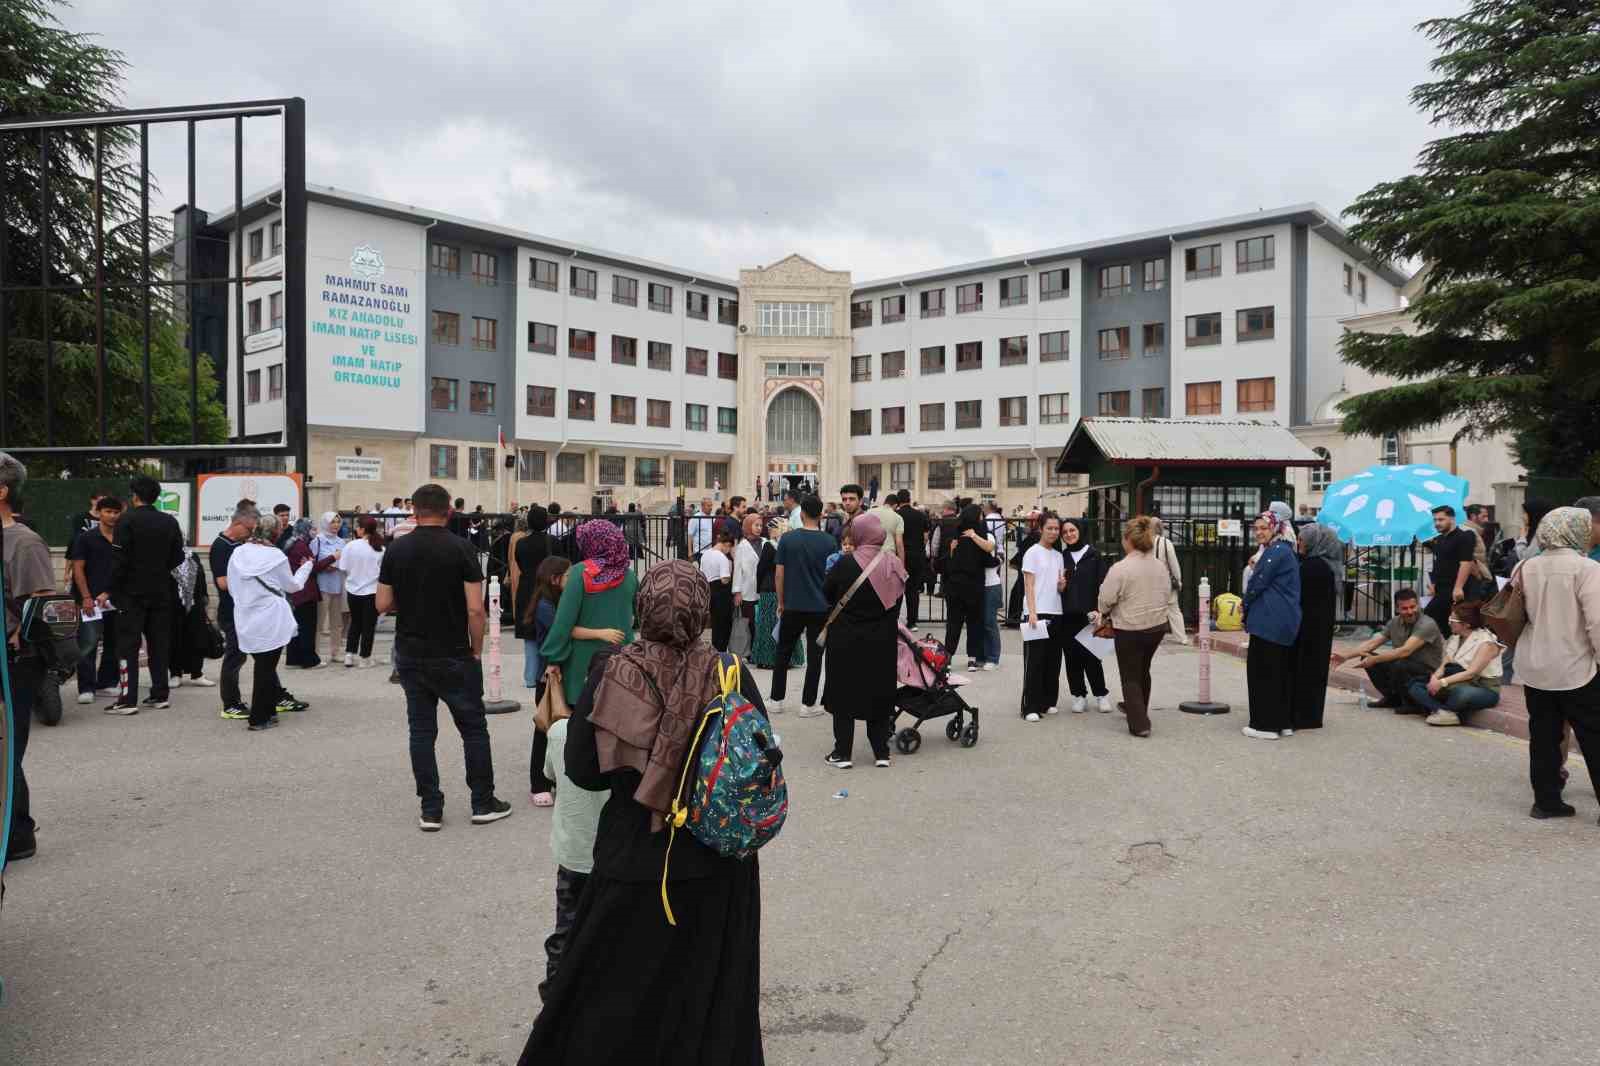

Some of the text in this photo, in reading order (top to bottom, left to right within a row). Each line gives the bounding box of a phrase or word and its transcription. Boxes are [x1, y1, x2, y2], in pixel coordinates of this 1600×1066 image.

[325, 274, 376, 292] MAHMUT
[351, 311, 404, 328] ANADOLU
[312, 321, 346, 336] İMAM
[349, 325, 381, 340] HATİP
[361, 344, 376, 356] VE
[332, 354, 402, 372] İMAM HATİP
[334, 371, 401, 388] ORTAOKULU
[1227, 600, 1236, 616] 7
